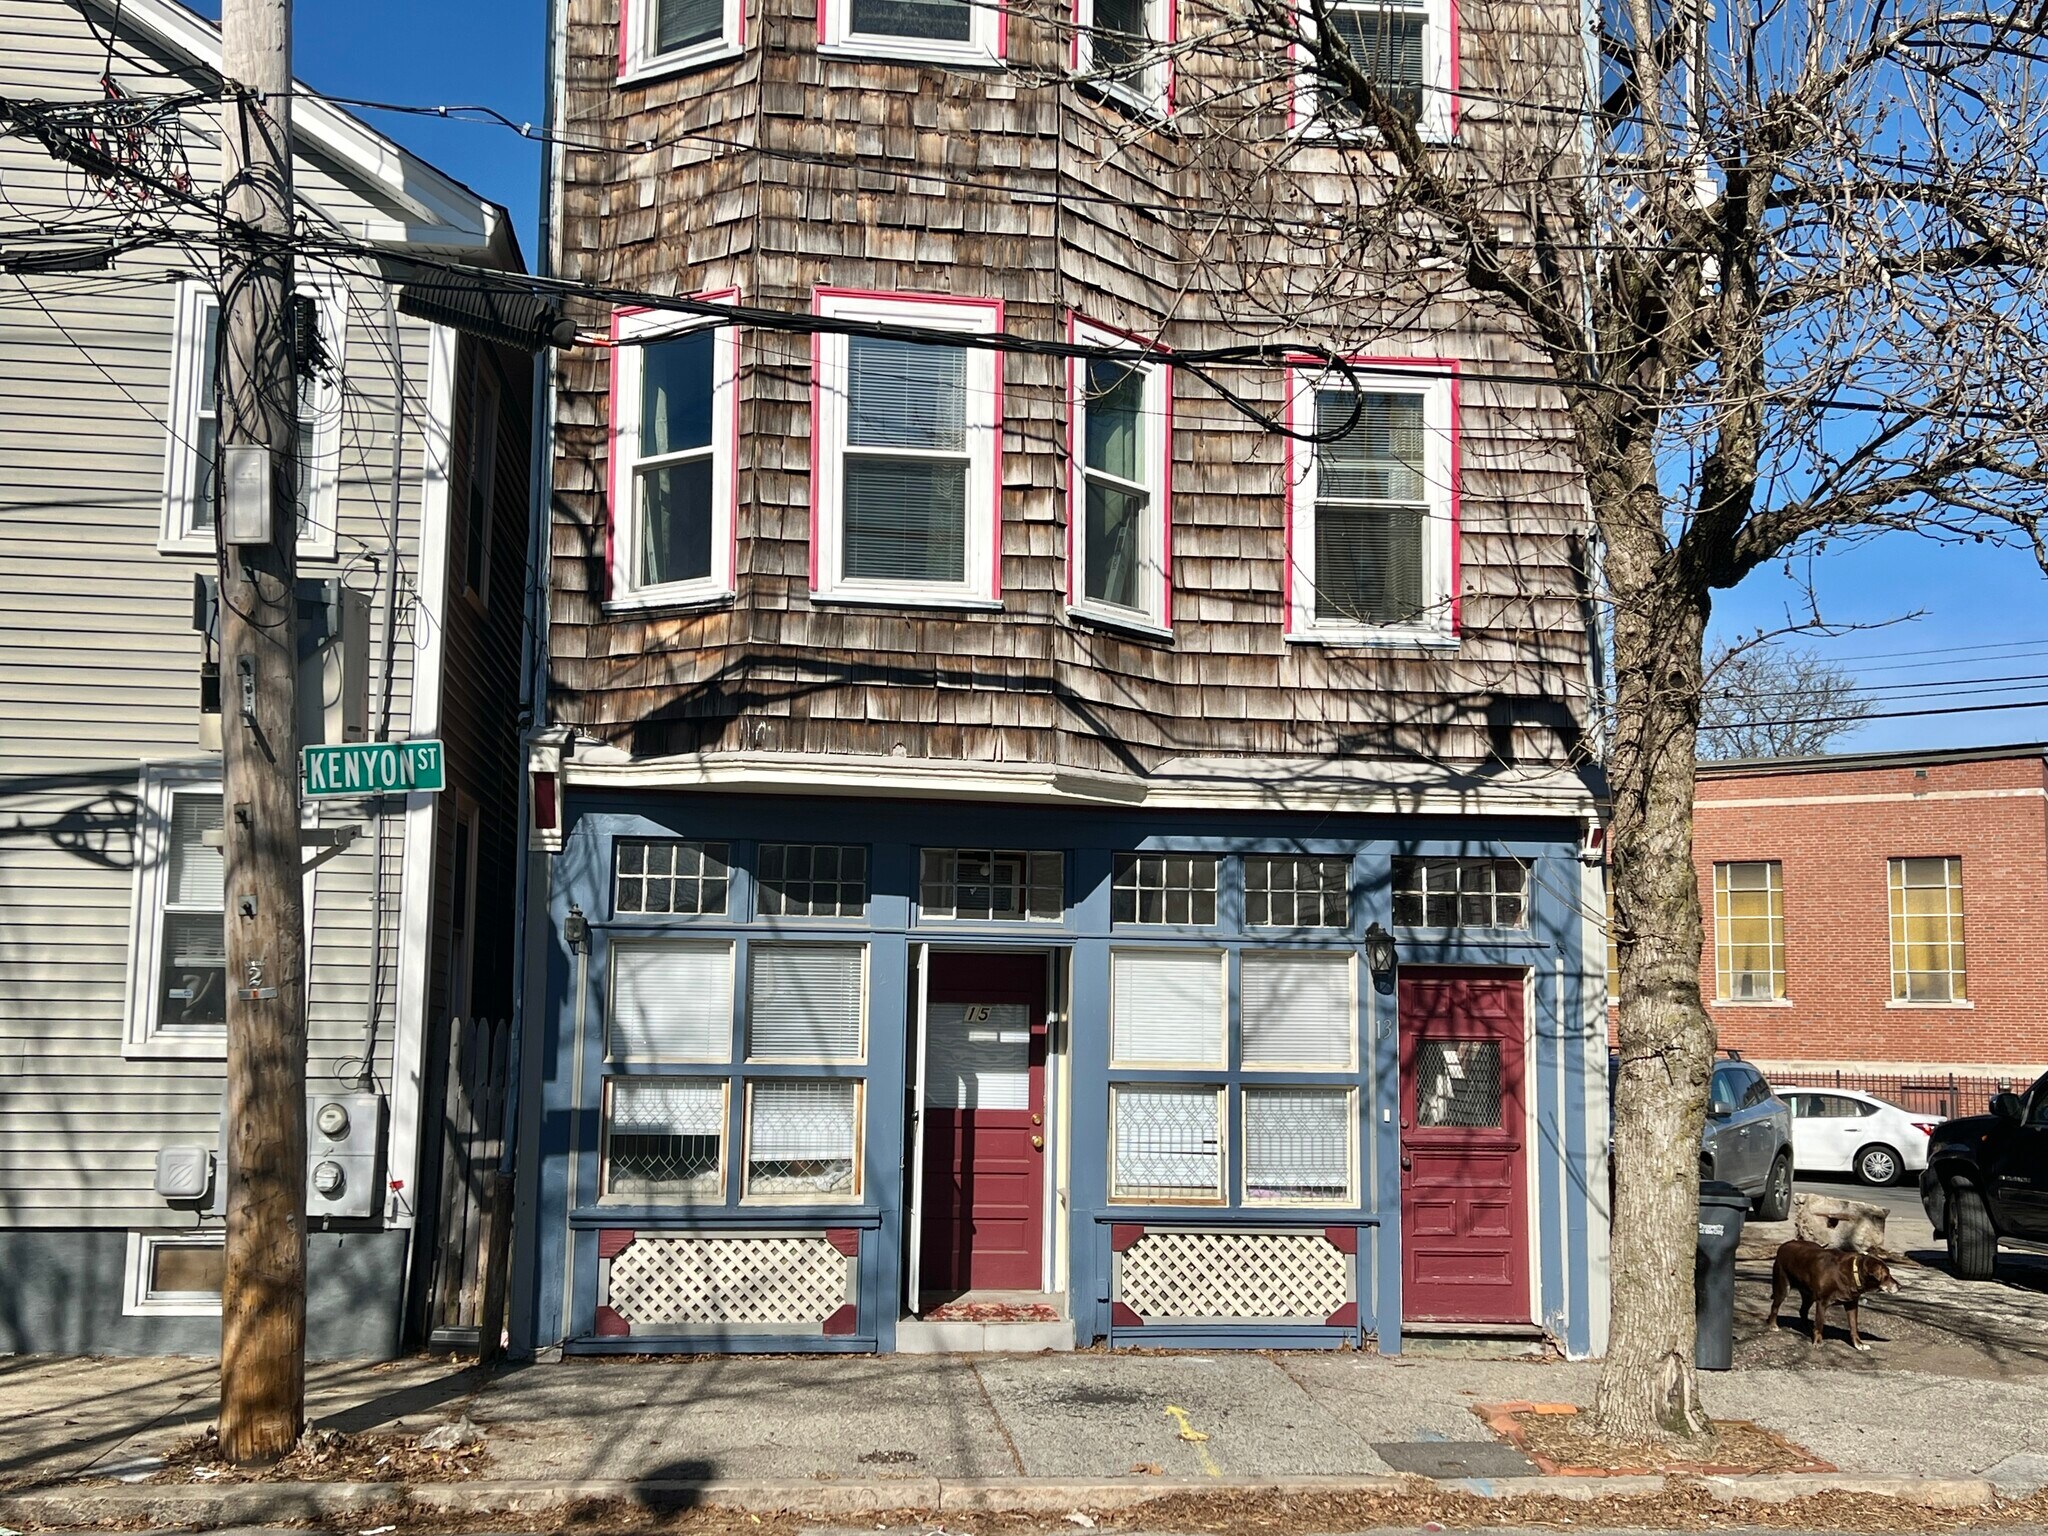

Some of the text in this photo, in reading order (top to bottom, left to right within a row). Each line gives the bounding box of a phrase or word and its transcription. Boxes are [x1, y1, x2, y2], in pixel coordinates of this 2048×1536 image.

[310, 748, 437, 789] KENYON ST
[248, 967, 263, 987] 2
[967, 1006, 990, 1021] 15
[1375, 1019, 1392, 1040] 13
